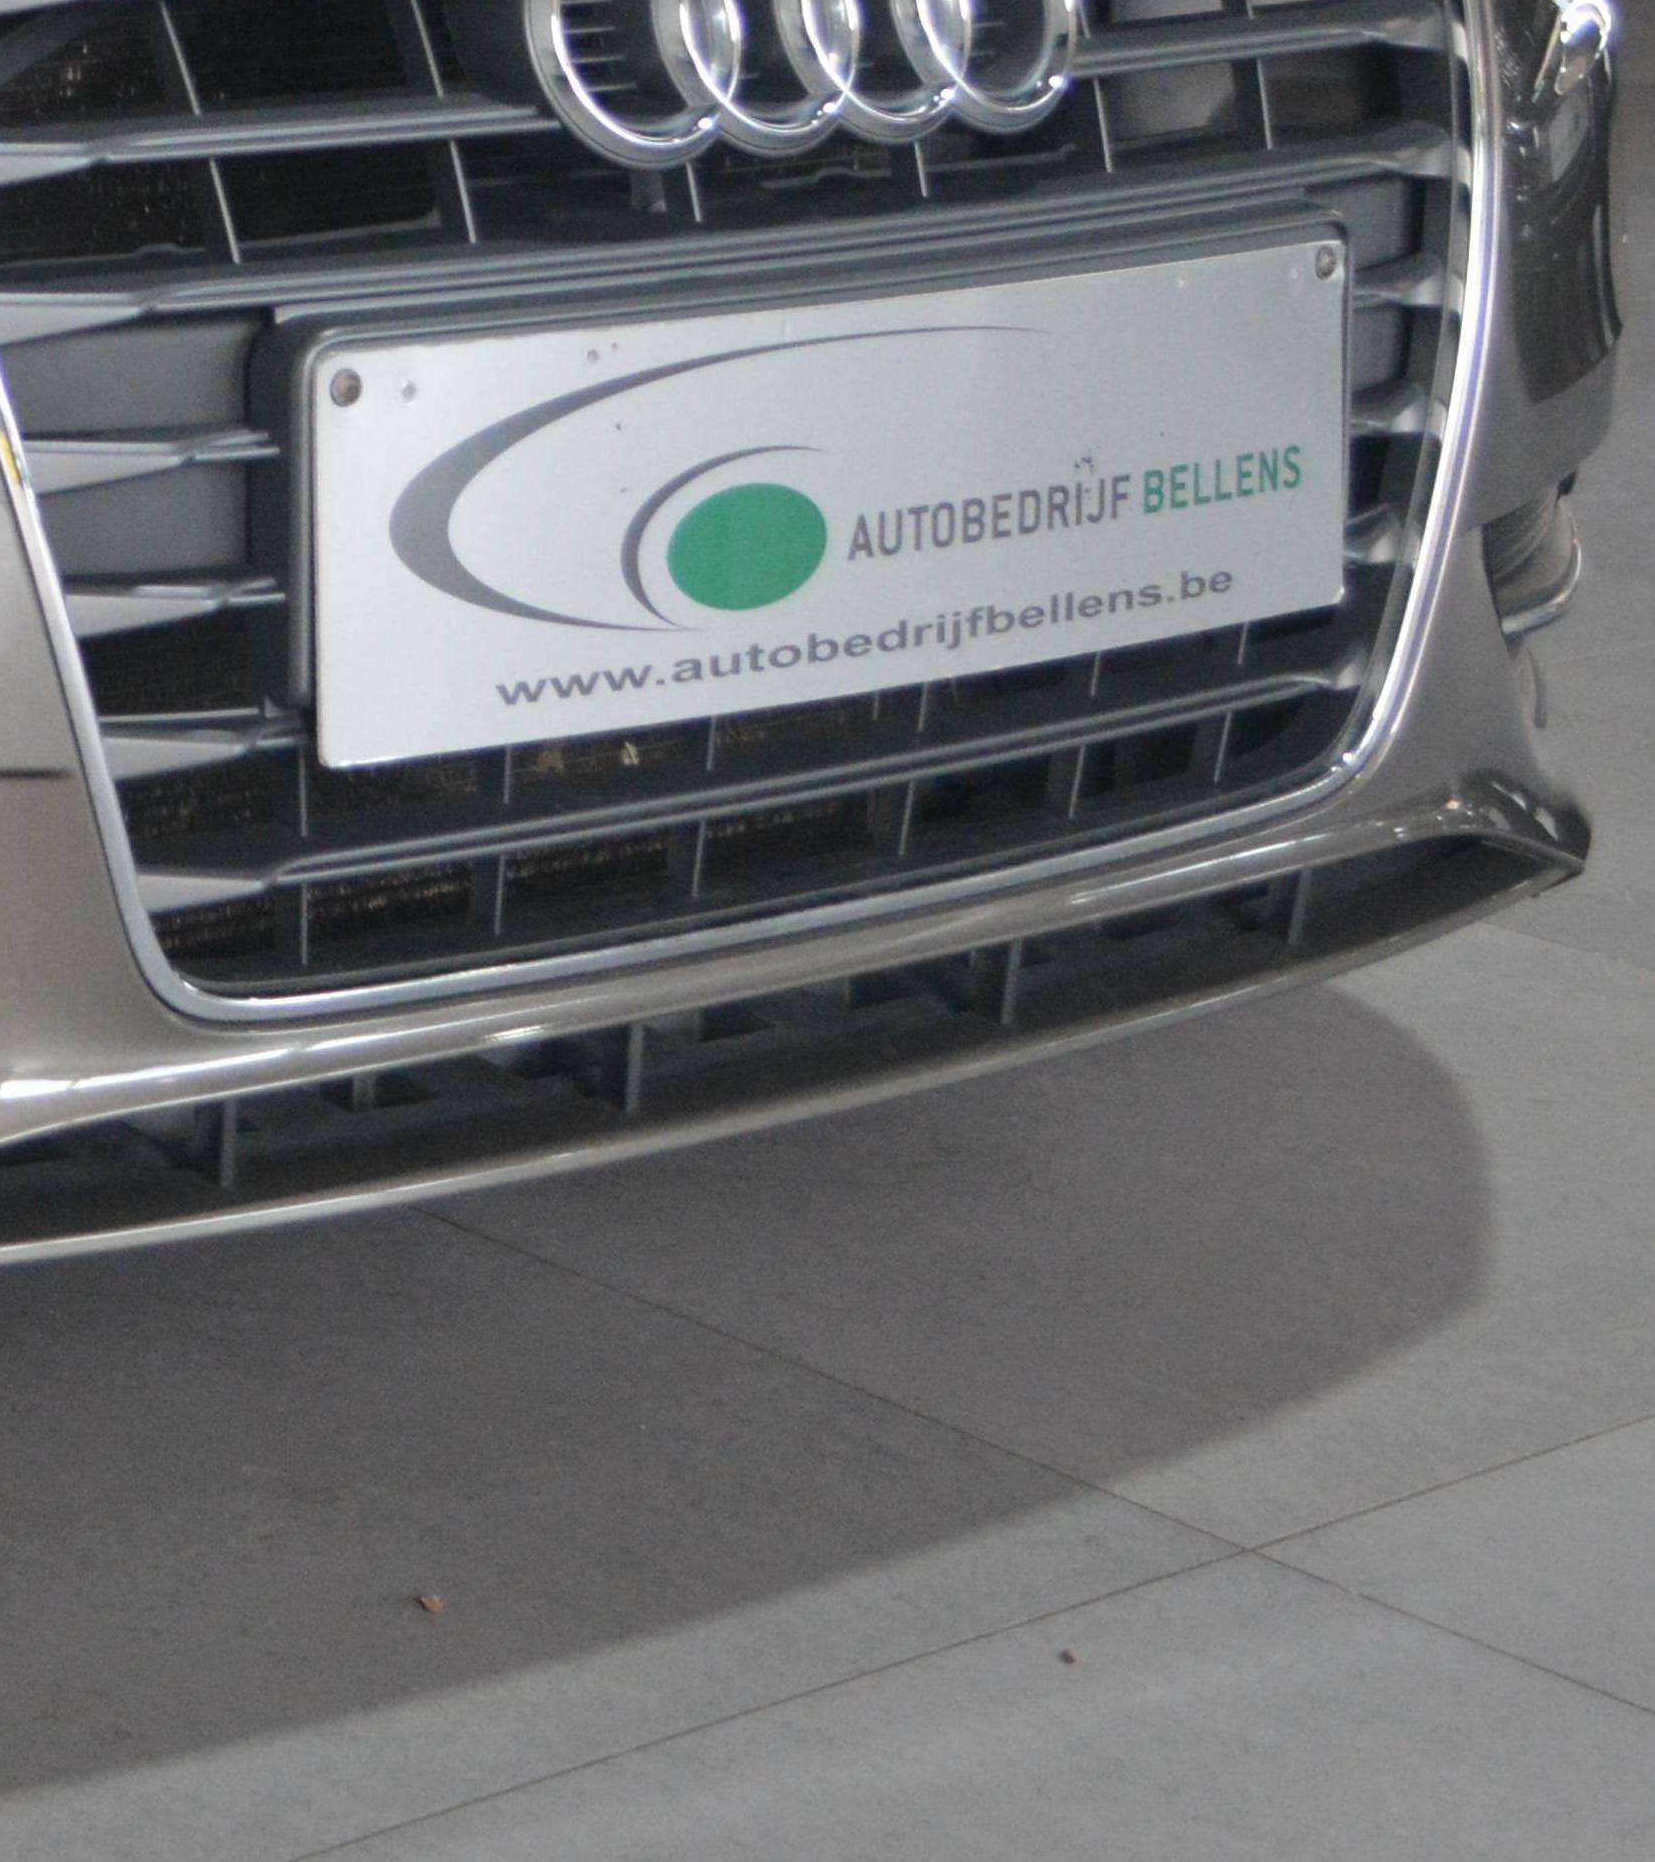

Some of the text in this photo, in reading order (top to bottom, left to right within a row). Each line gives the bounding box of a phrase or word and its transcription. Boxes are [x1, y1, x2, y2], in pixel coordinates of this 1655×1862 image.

[847, 444, 1303, 561] AUTOBEDRIJF BELLENS
[495, 564, 1234, 708] www.autobedrijfbellens.be
